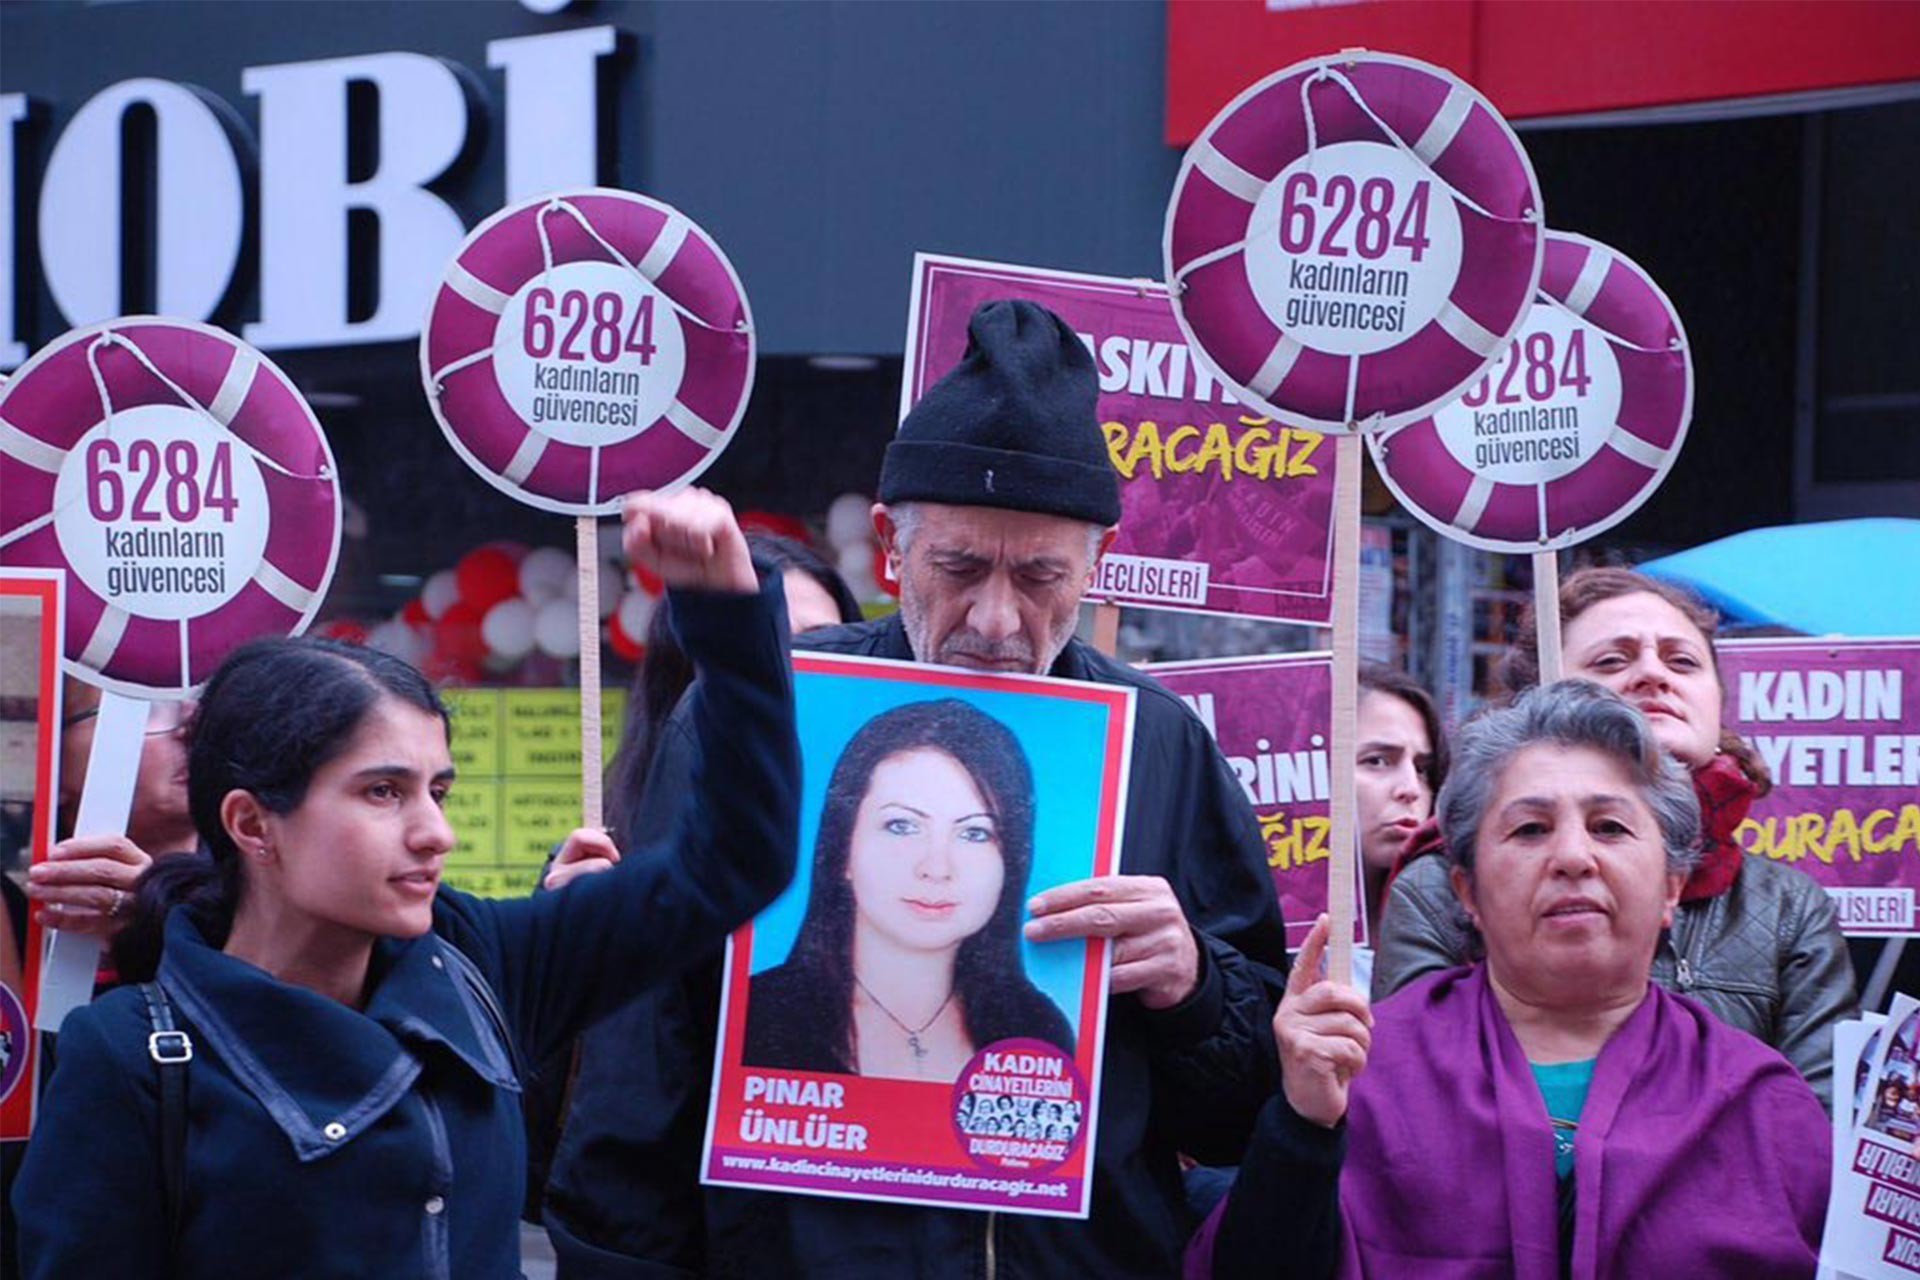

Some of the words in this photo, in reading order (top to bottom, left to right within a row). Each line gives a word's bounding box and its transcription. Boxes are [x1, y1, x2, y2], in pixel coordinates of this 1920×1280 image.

[0, 0, 616, 365] OBİ
[1278, 172, 1430, 262] 6284
[1289, 259, 1409, 297] kadınların
[523, 286, 657, 367] 6284
[1286, 293, 1406, 333] güvencesi
[534, 365, 640, 396] kadınların
[1076, 333, 1239, 405] SKIY
[532, 393, 638, 428] güvencesi
[1474, 406, 1578, 437] kadınların
[1476, 431, 1580, 469] güvencesi
[84, 438, 239, 524] 6284
[105, 526, 225, 560] kadınların
[107, 557, 227, 598] güvencesi
[1101, 561, 1200, 600] ECLİSLERİ
[1739, 669, 1902, 721] KADIN
[1739, 735, 1920, 786] YETLER
[984, 1053, 1063, 1077] KADIN
[744, 1075, 845, 1108] PINAR
[738, 1108, 868, 1152] ÜNLÜER
